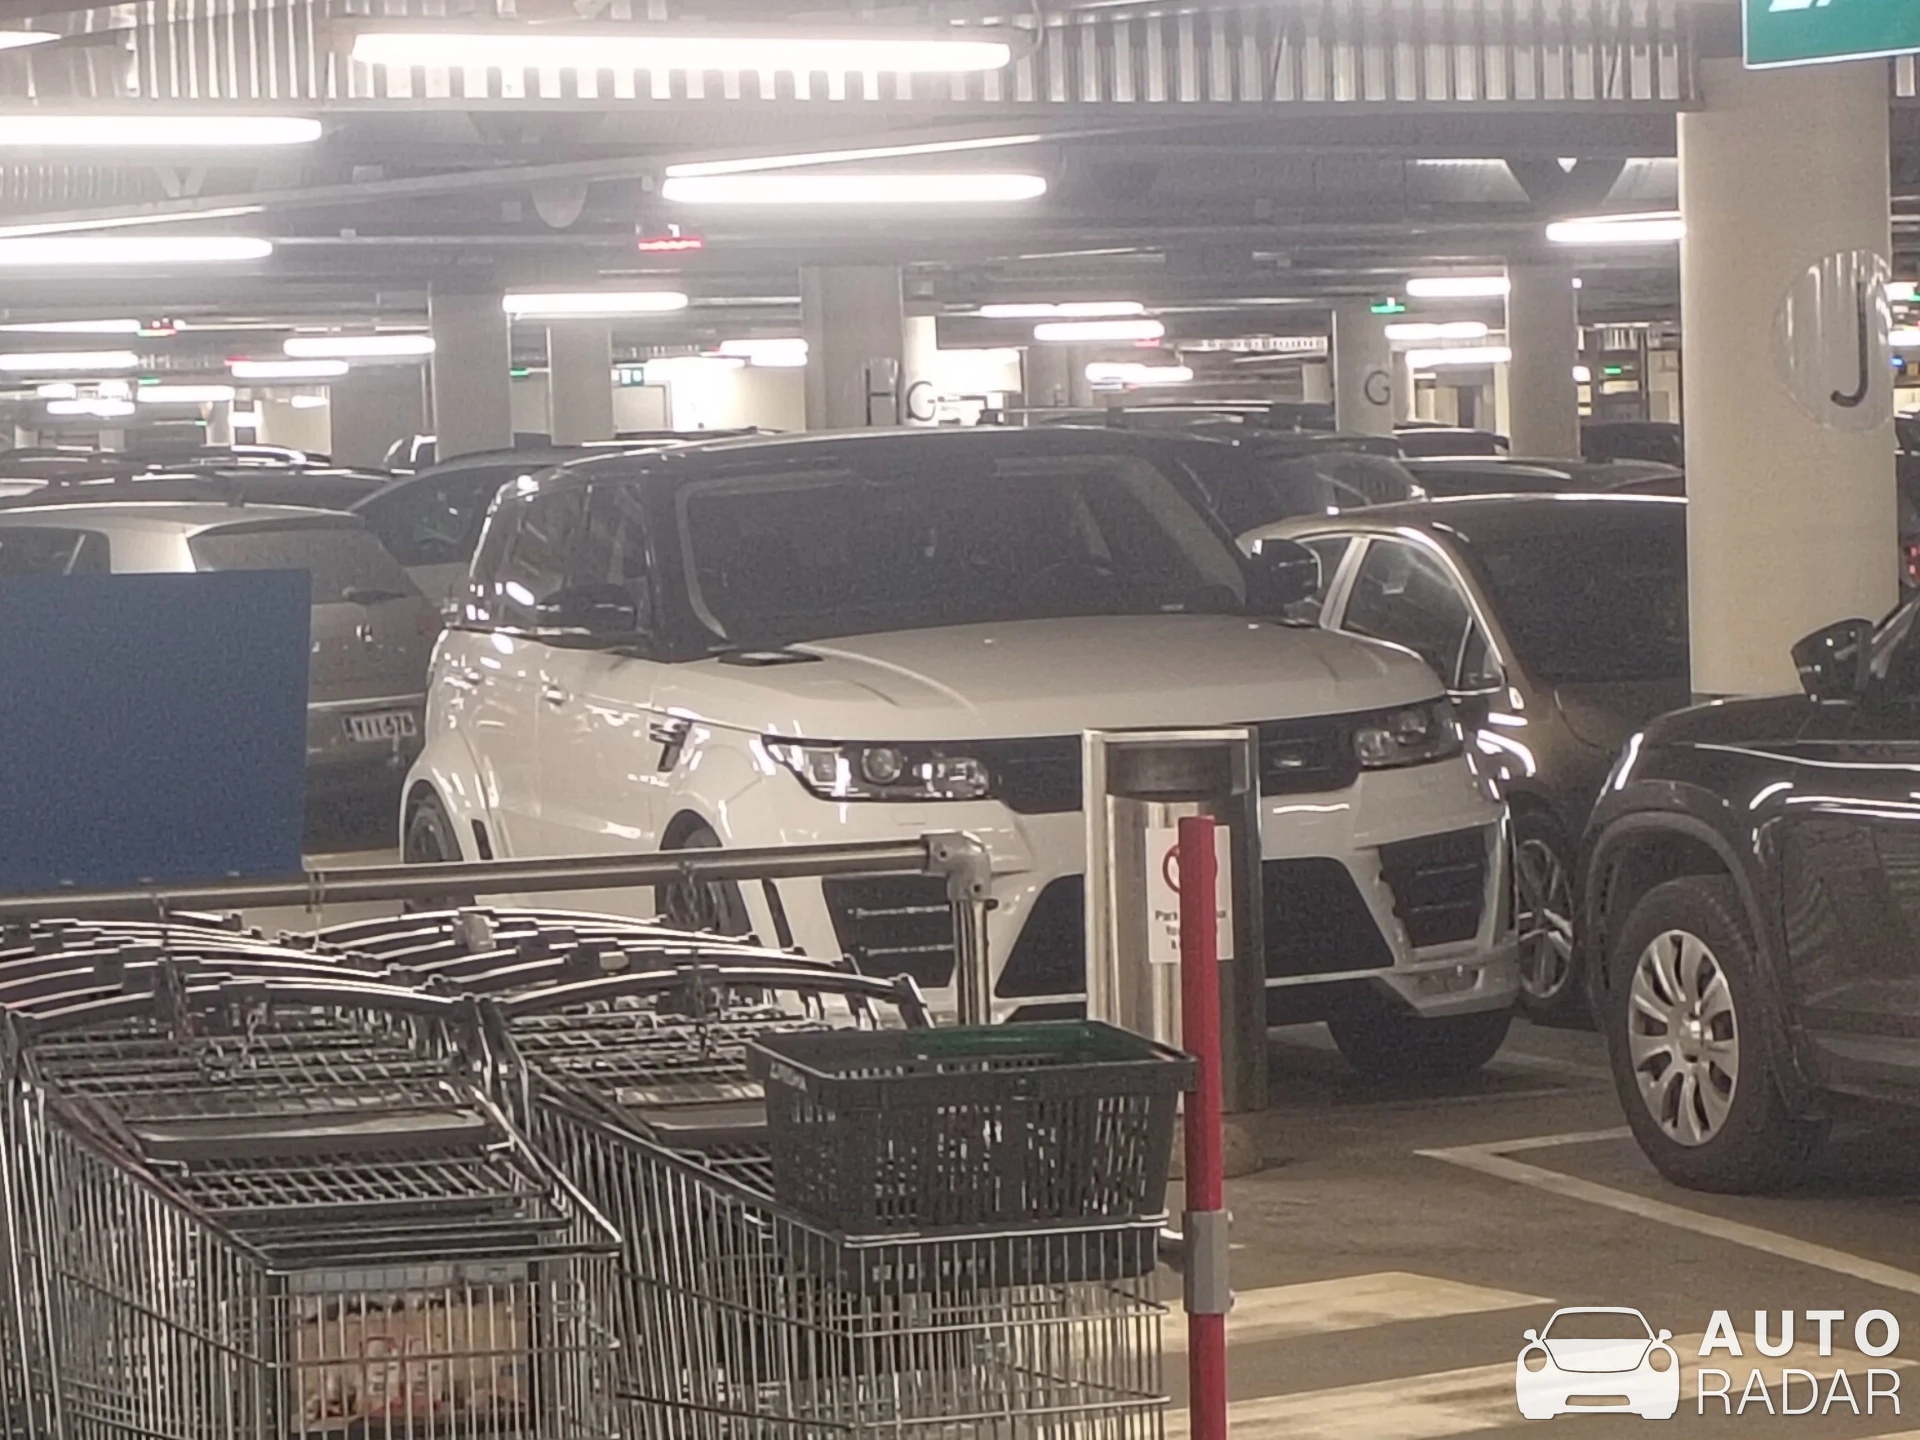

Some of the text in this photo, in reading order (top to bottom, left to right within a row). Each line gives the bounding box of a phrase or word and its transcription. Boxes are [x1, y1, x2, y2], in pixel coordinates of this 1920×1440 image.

[1830, 279, 1868, 408] J
[865, 367, 902, 426] H
[906, 380, 936, 422] G
[1364, 370, 1391, 406] G
